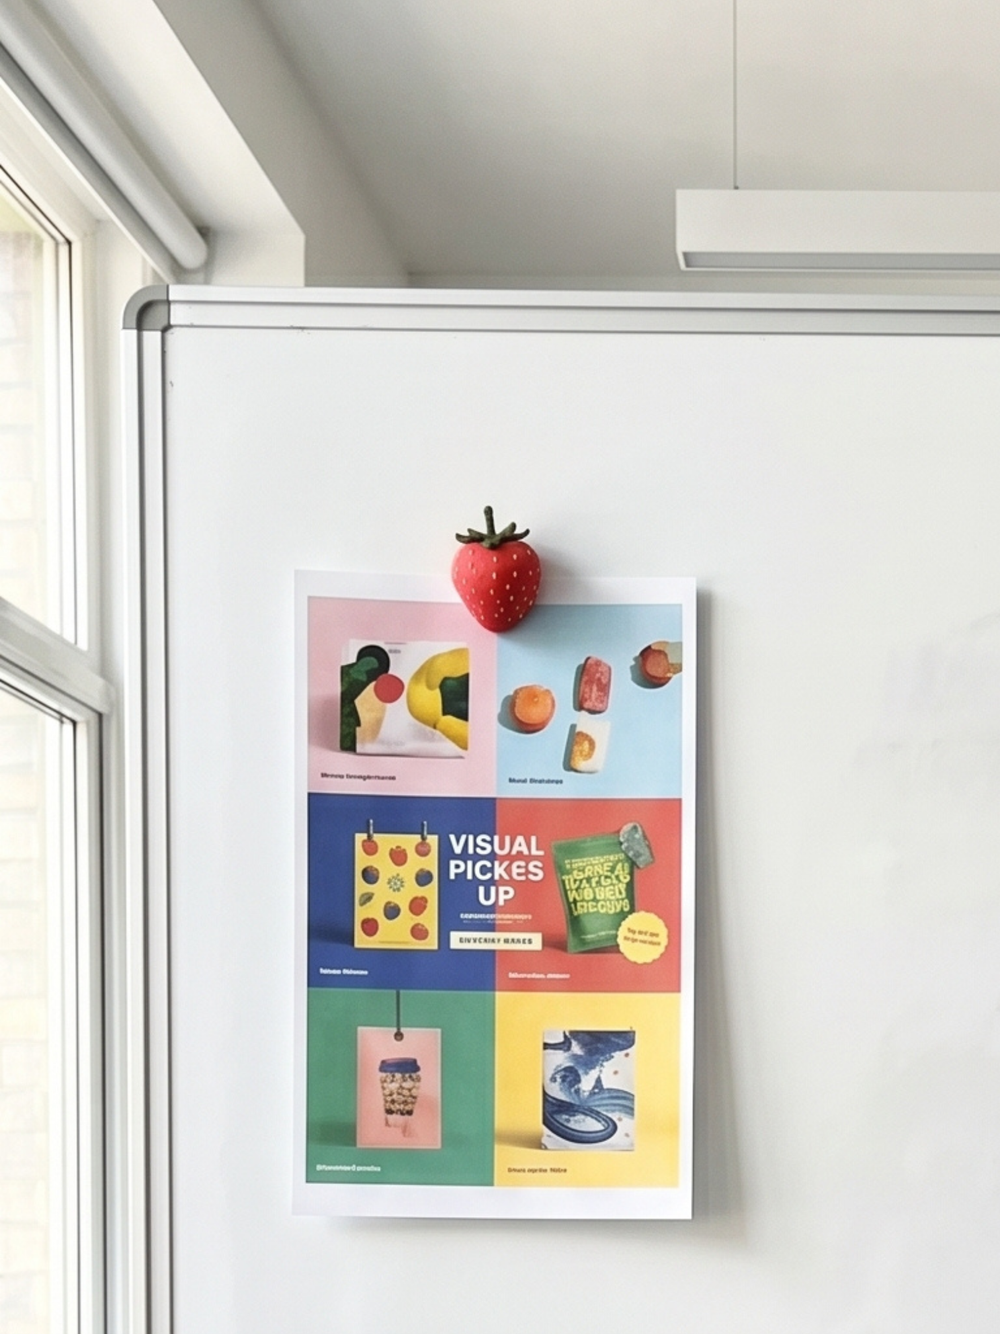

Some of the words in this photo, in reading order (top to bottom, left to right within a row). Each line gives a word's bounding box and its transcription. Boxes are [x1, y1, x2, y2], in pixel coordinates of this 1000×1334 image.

[449, 833, 545, 856] VISUAL
[449, 859, 544, 881] PICKES
[478, 885, 515, 906] UP
